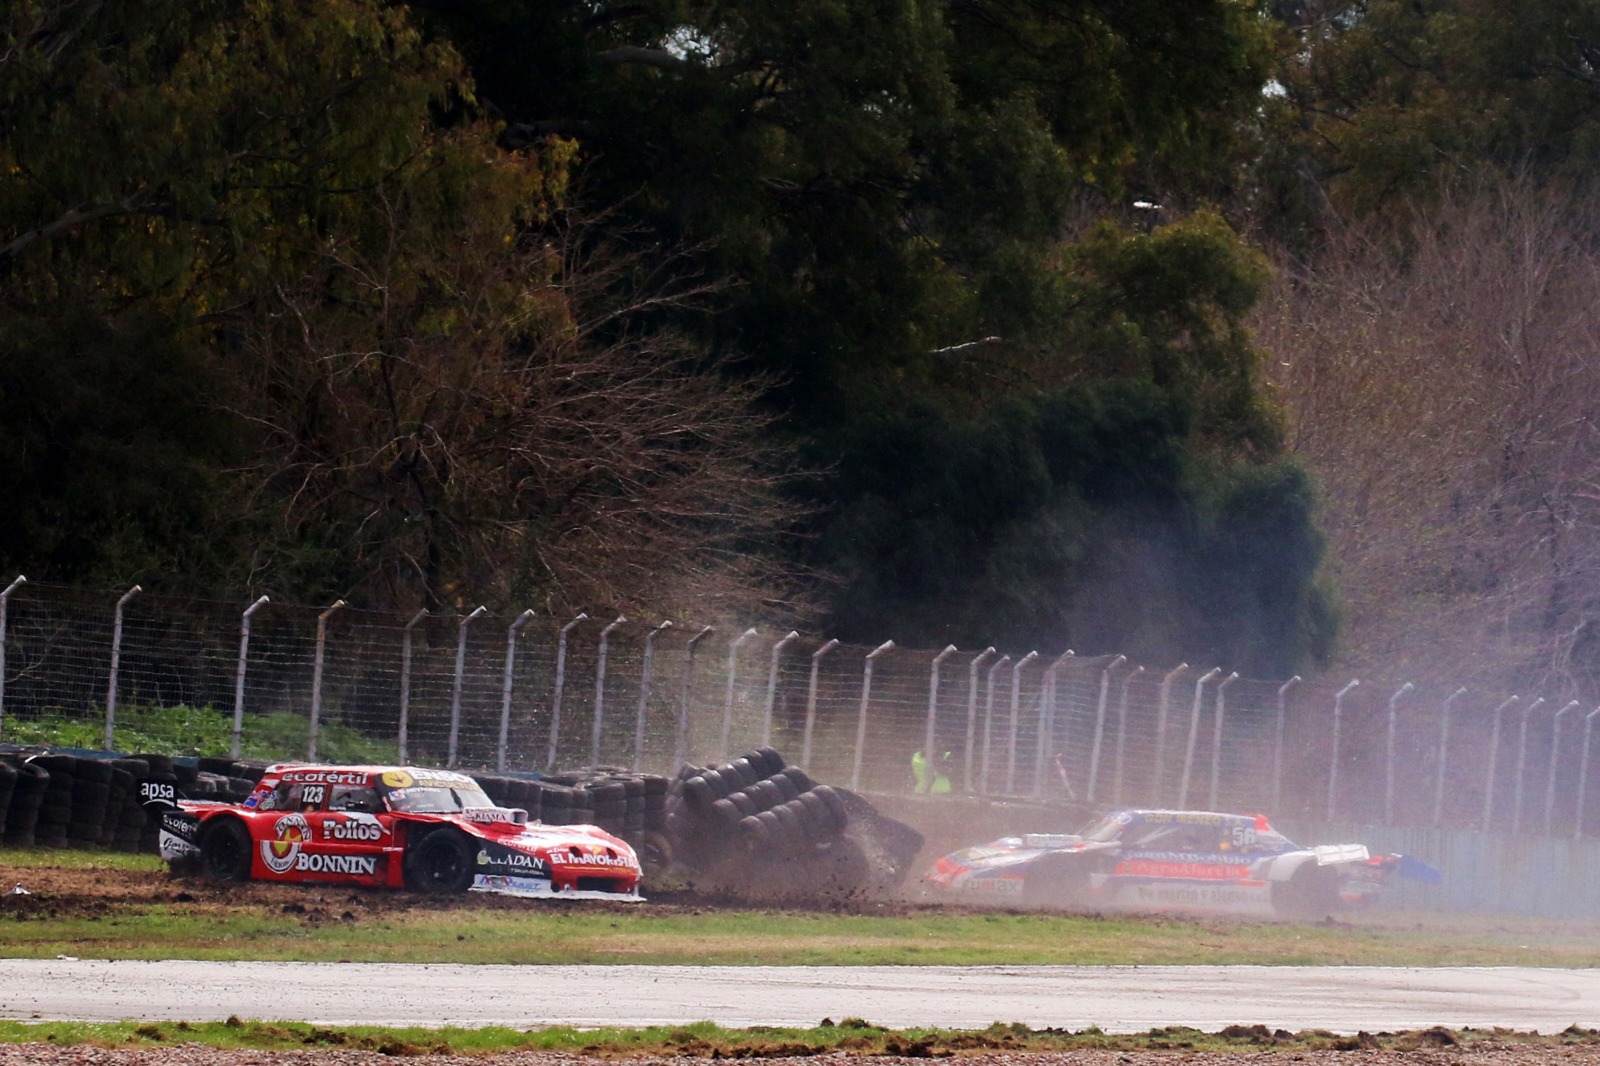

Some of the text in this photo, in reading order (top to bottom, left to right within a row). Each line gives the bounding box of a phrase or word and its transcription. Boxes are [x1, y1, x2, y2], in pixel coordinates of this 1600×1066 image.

[282, 771, 368, 784] ecofértil
[141, 782, 174, 800] apsa
[303, 786, 324, 803] 123
[475, 812, 507, 821] KIAMA
[1232, 827, 1256, 846] 56
[295, 853, 377, 874] BONNIN
[550, 853, 567, 864] EL
